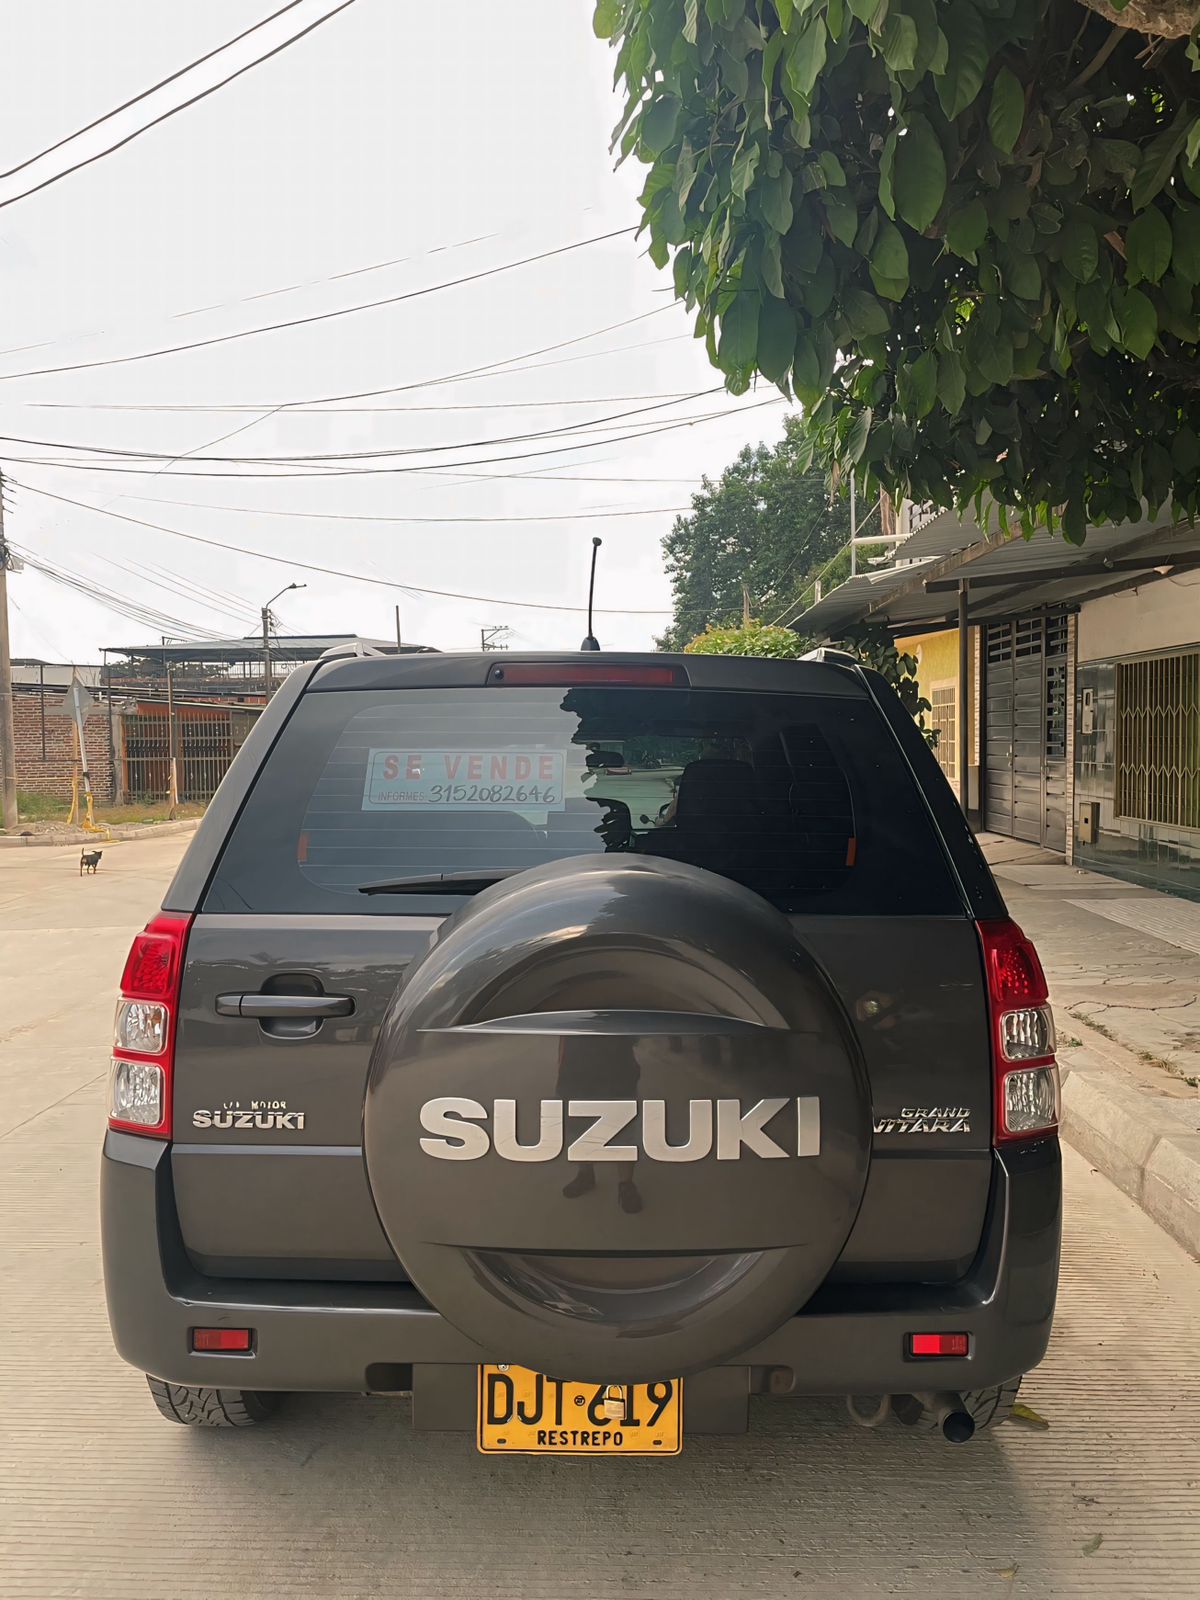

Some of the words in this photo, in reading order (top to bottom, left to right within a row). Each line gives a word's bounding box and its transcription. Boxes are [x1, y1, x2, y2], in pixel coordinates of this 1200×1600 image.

[383, 754, 422, 780] SE
[443, 754, 554, 780] VENDE
[378, 791, 425, 801] INFORMES
[428, 784, 555, 803] 3152082646
[192, 1109, 305, 1130] SUZUKI
[901, 1107, 971, 1118] GRAND
[419, 1096, 822, 1162] SUZUKI
[873, 1118, 971, 1133] VITARA
[487, 1373, 572, 1426] DJT
[537, 1429, 624, 1446] RESTREPO
